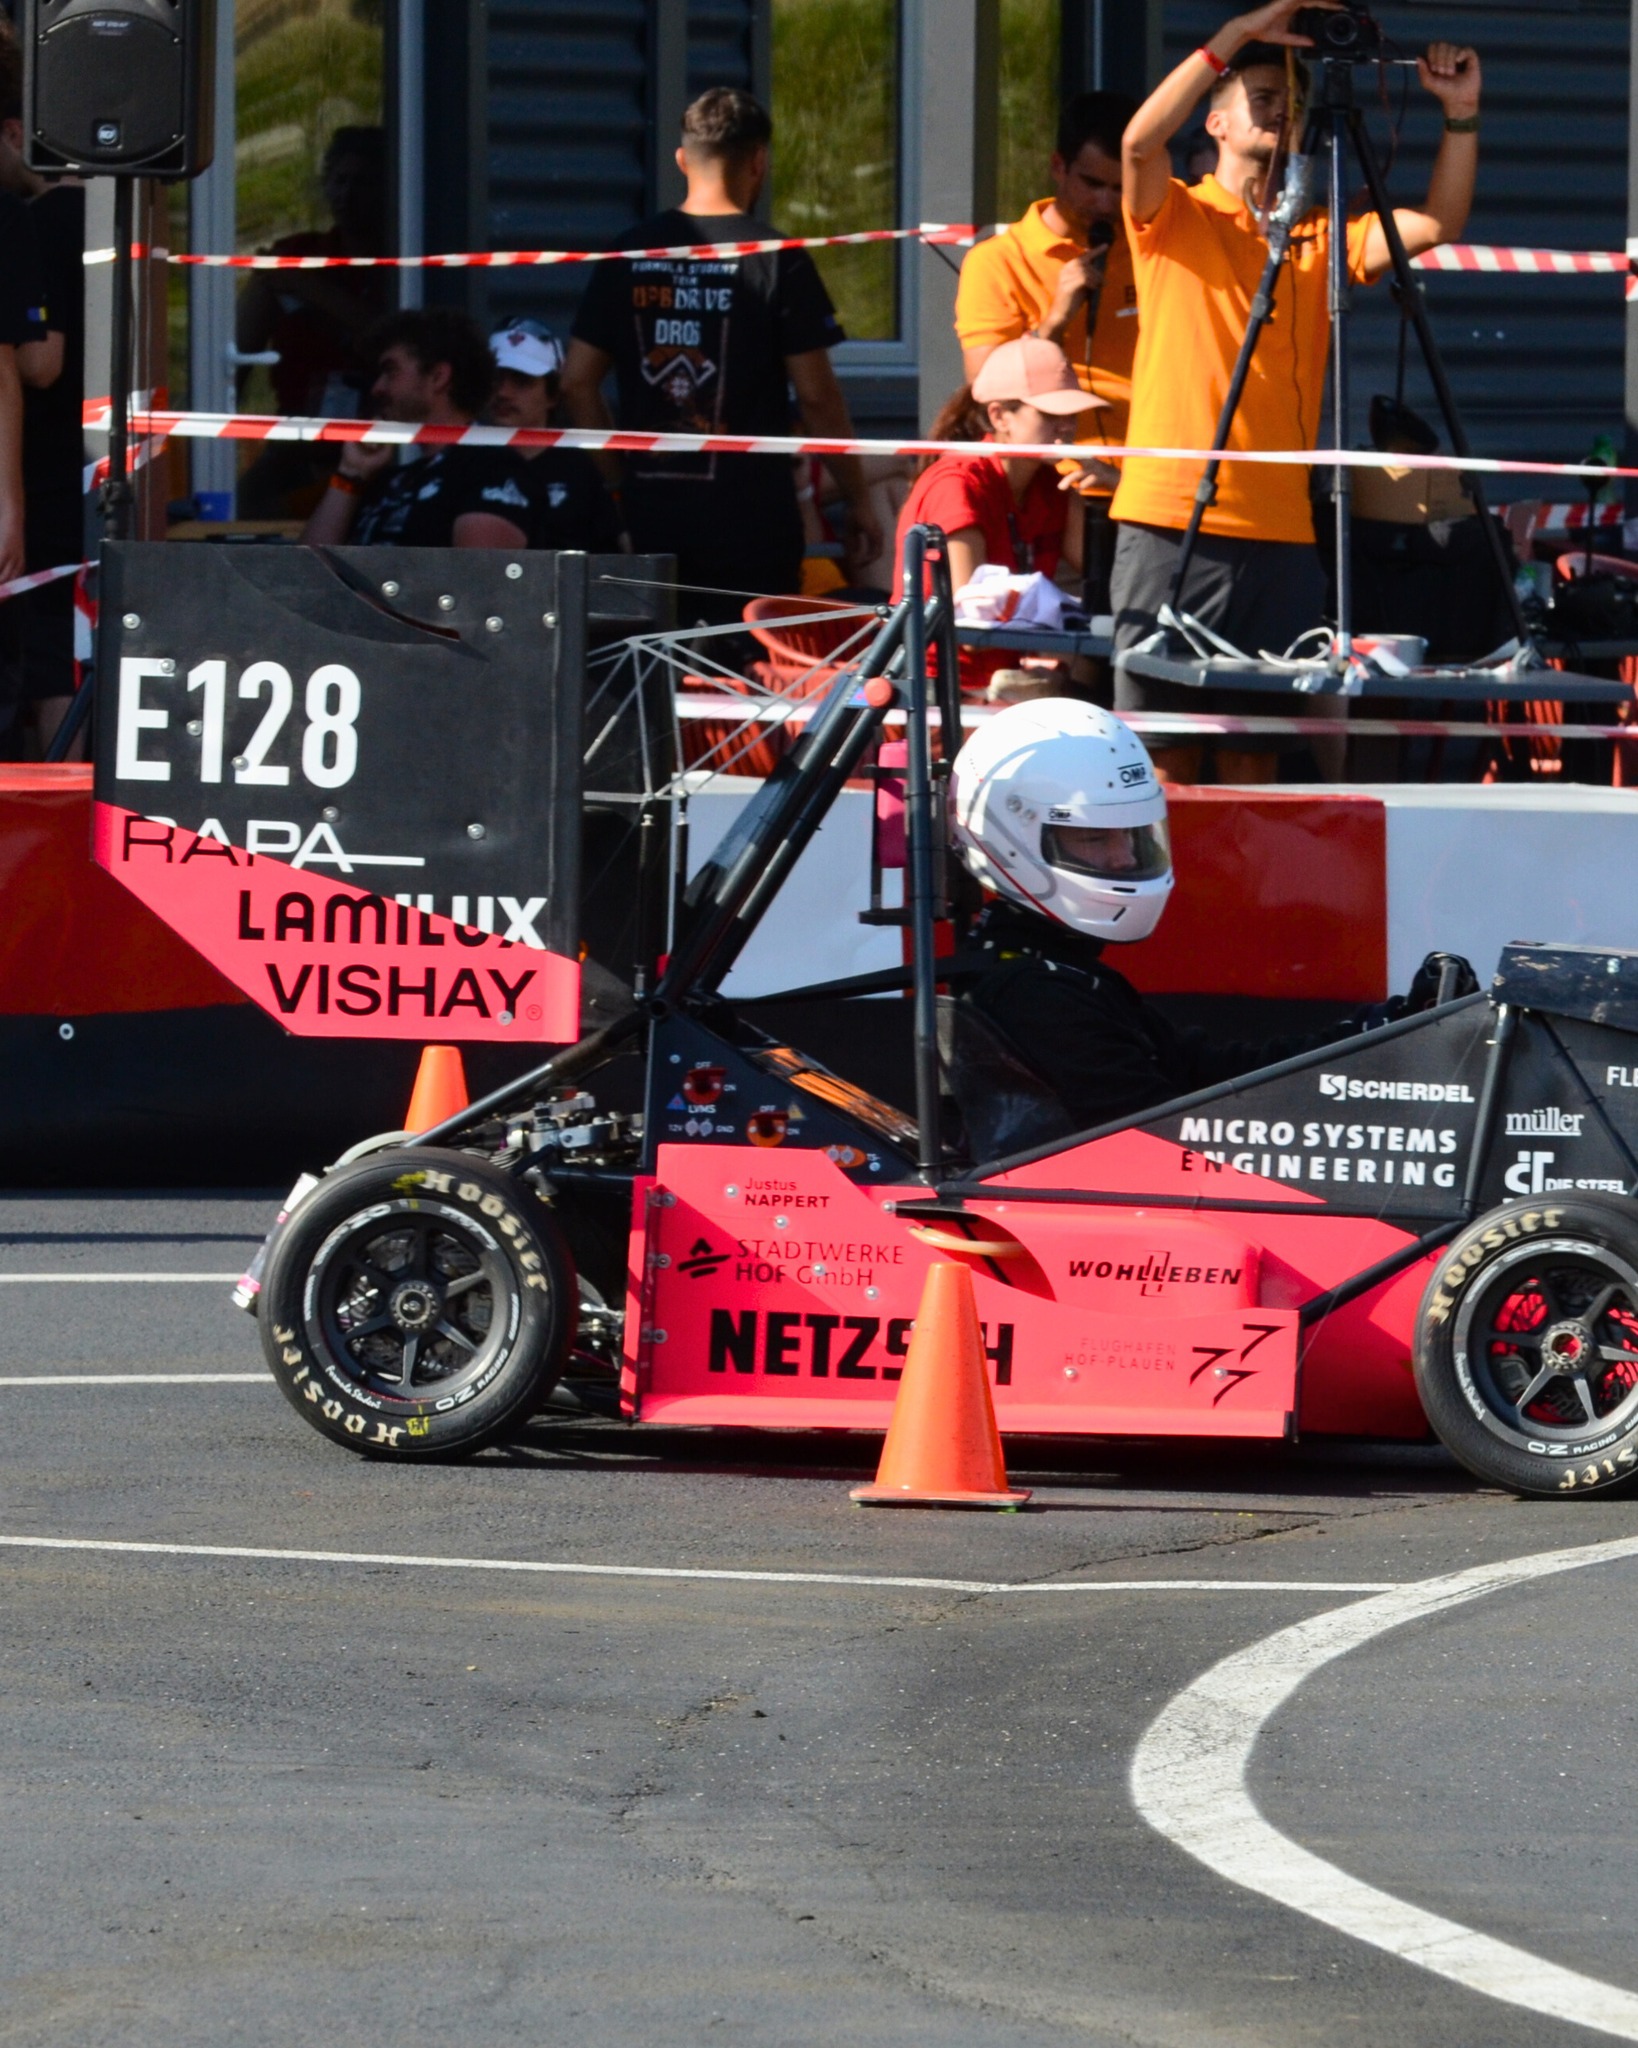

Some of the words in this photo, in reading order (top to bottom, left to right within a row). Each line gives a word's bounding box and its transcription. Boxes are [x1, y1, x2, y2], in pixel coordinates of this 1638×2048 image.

[115, 656, 361, 789] E128
[1120, 768, 1146, 784] OMP
[1048, 809, 1071, 820] OMP
[122, 815, 425, 873] RAPA
[238, 889, 547, 950] LAMILUX
[265, 962, 538, 1020] VISHAY
[1347, 1079, 1475, 1103] SCHERDEL
[1505, 1107, 1585, 1135] müller
[1179, 1117, 1295, 1146] MICRO
[1303, 1122, 1457, 1154] SYSTEMS
[1181, 1150, 1456, 1187] ENGINEERING
[744, 1177, 798, 1191] Justus
[744, 1193, 831, 1208] NAPPERT
[737, 1239, 905, 1265] STADTWERKE
[735, 1263, 787, 1284] HOF
[796, 1265, 874, 1287] GmbH
[1068, 1254, 1243, 1290] WOHLLEBEN
[708, 1309, 1015, 1386] NETZSH
[1064, 1353, 1175, 1372] HOF-PLAUEN
[1572, 1432, 1618, 1455] RACING
